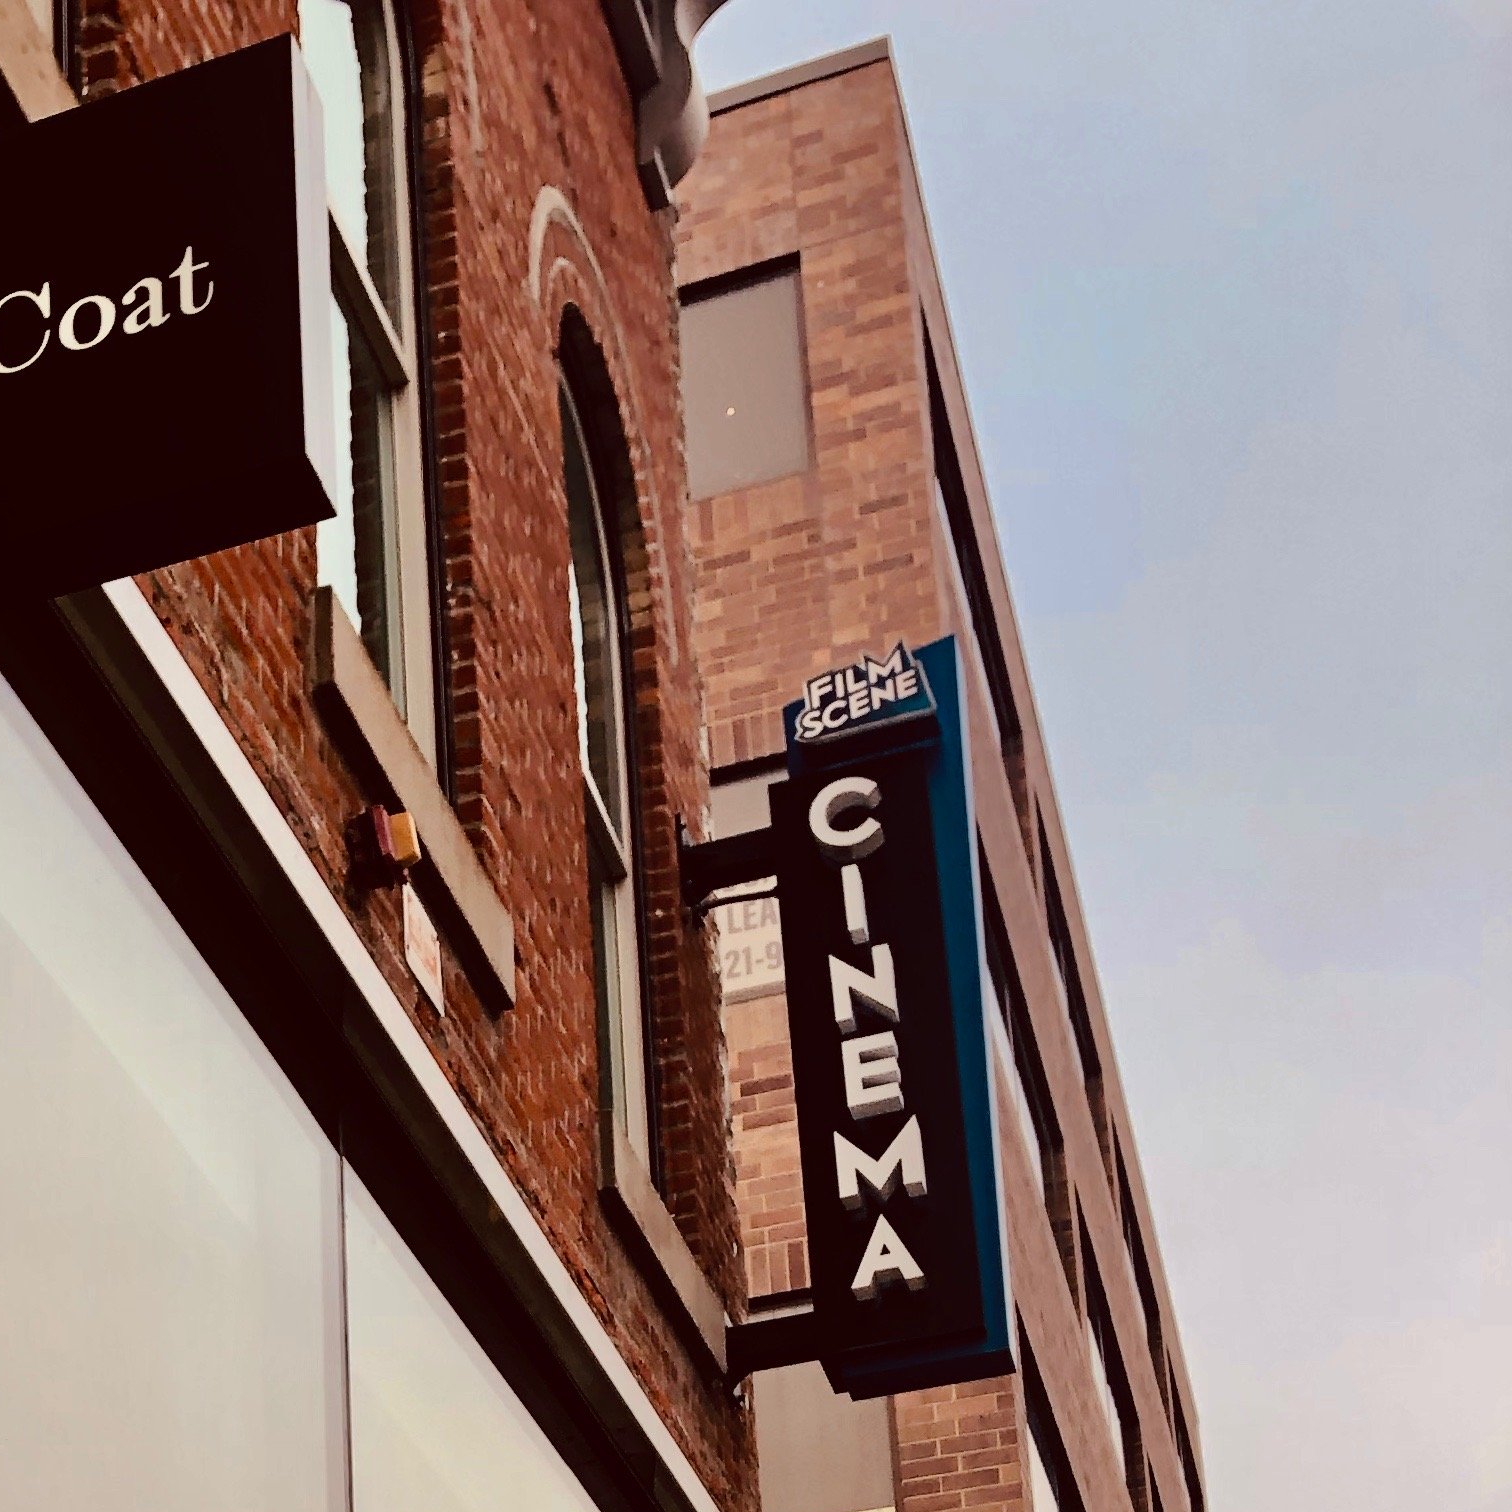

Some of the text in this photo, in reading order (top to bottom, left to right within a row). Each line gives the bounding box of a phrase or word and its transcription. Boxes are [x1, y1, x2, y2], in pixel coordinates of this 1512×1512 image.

[801, 668, 918, 739] SCENE
[809, 649, 904, 709] FILM
[809, 777, 926, 1296] CINEMA
